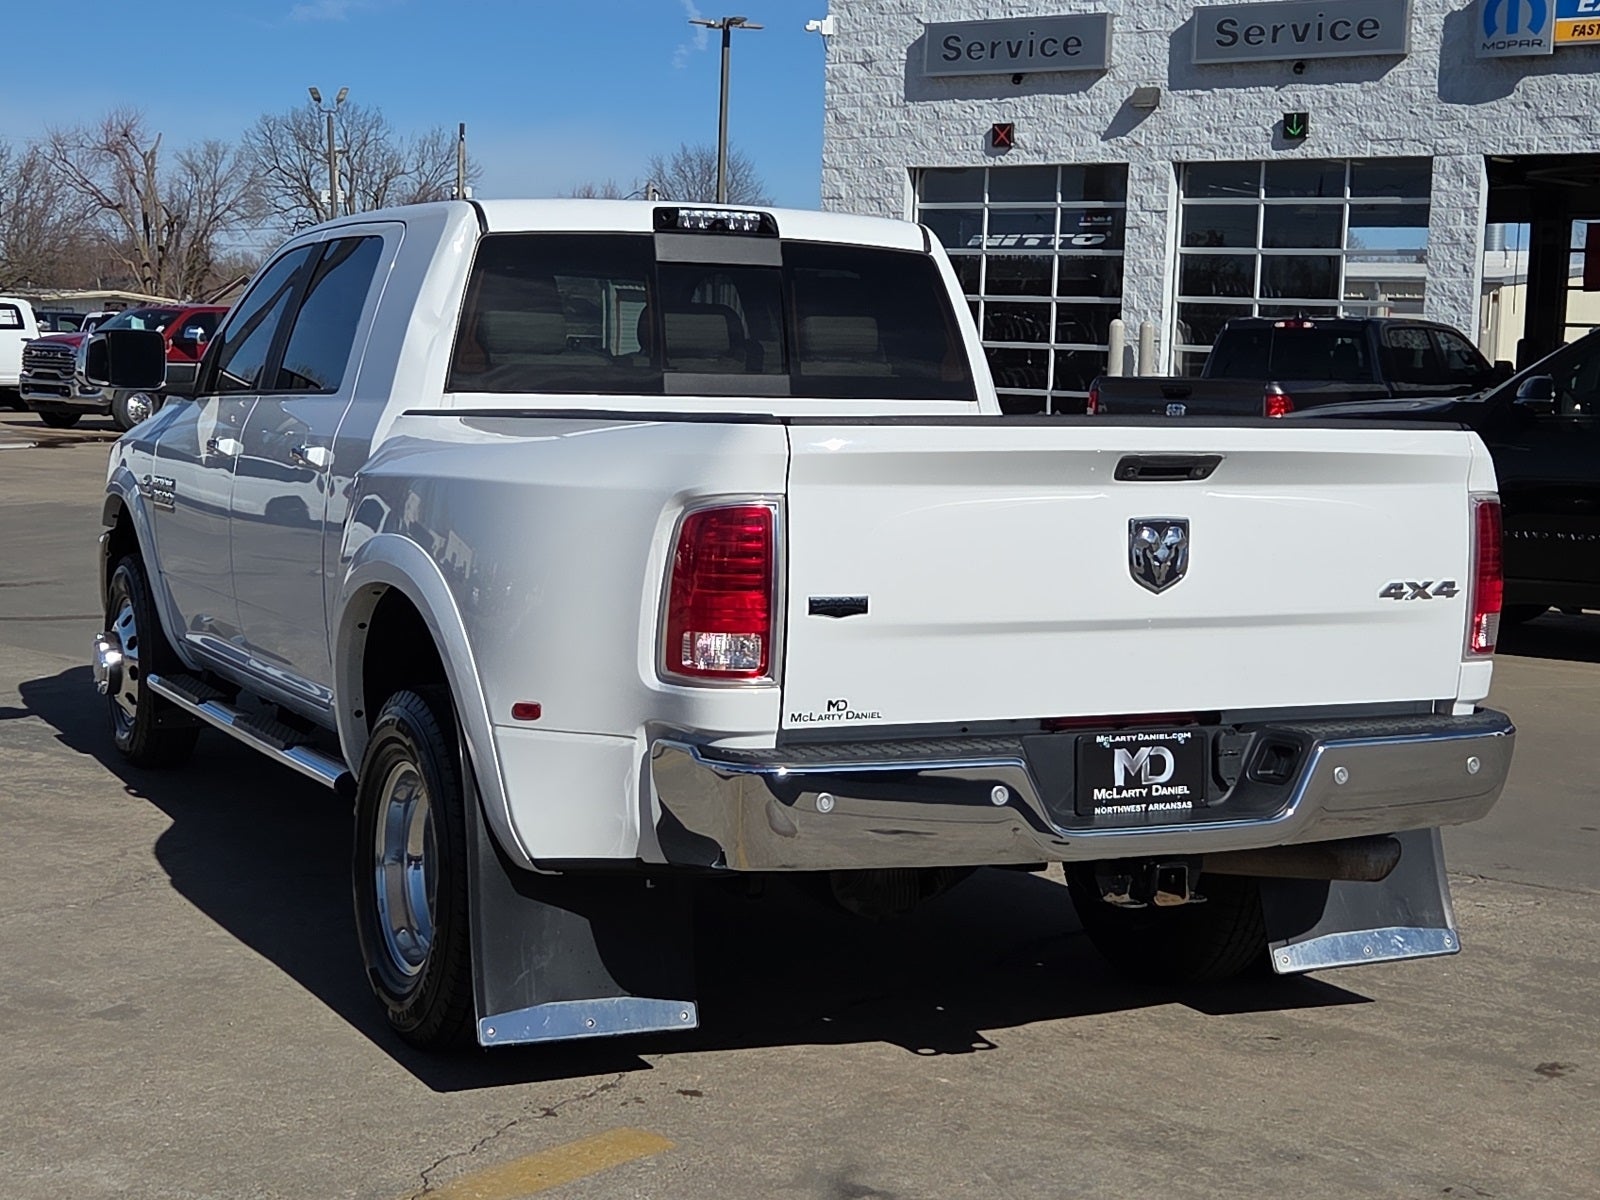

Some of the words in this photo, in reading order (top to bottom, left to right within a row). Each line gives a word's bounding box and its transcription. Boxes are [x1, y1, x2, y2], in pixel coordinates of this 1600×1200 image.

[1216, 13, 1380, 47] Service
[942, 31, 1082, 61] Service
[1482, 39, 1543, 50] MOPAR
[1379, 580, 1461, 600] 4X4
[845, 711, 882, 720] DANIEL
[1113, 746, 1175, 786] MD
[1093, 787, 1148, 800] McLARTY
[1151, 785, 1190, 796] DANIEL
[1094, 803, 1147, 815] NORTHWEST
[1147, 801, 1193, 812] ARKANSAS
